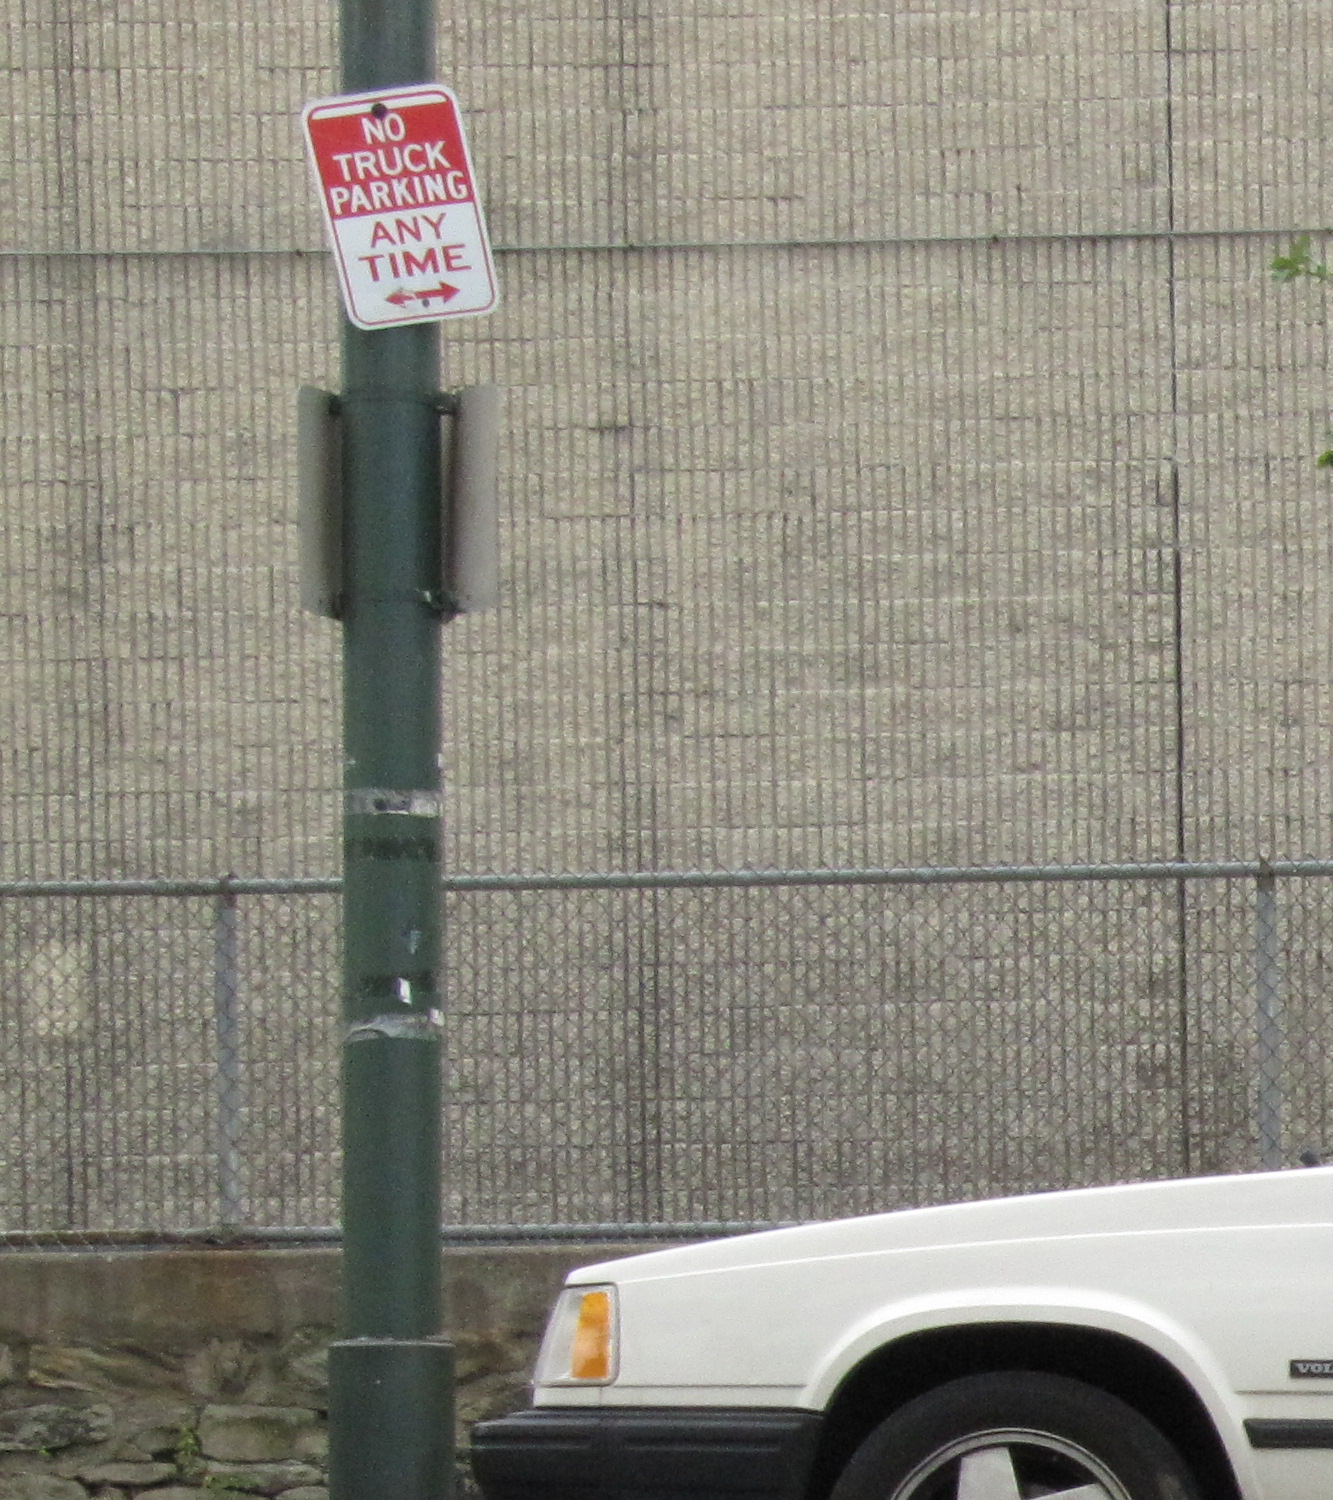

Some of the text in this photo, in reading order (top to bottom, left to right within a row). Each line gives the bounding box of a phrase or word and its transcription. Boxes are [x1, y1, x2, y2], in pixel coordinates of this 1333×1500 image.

[361, 112, 406, 144] NO
[332, 140, 451, 182] TRUCK
[330, 170, 468, 216] PARKING
[370, 212, 447, 248] ANY
[358, 243, 472, 282] TIME
